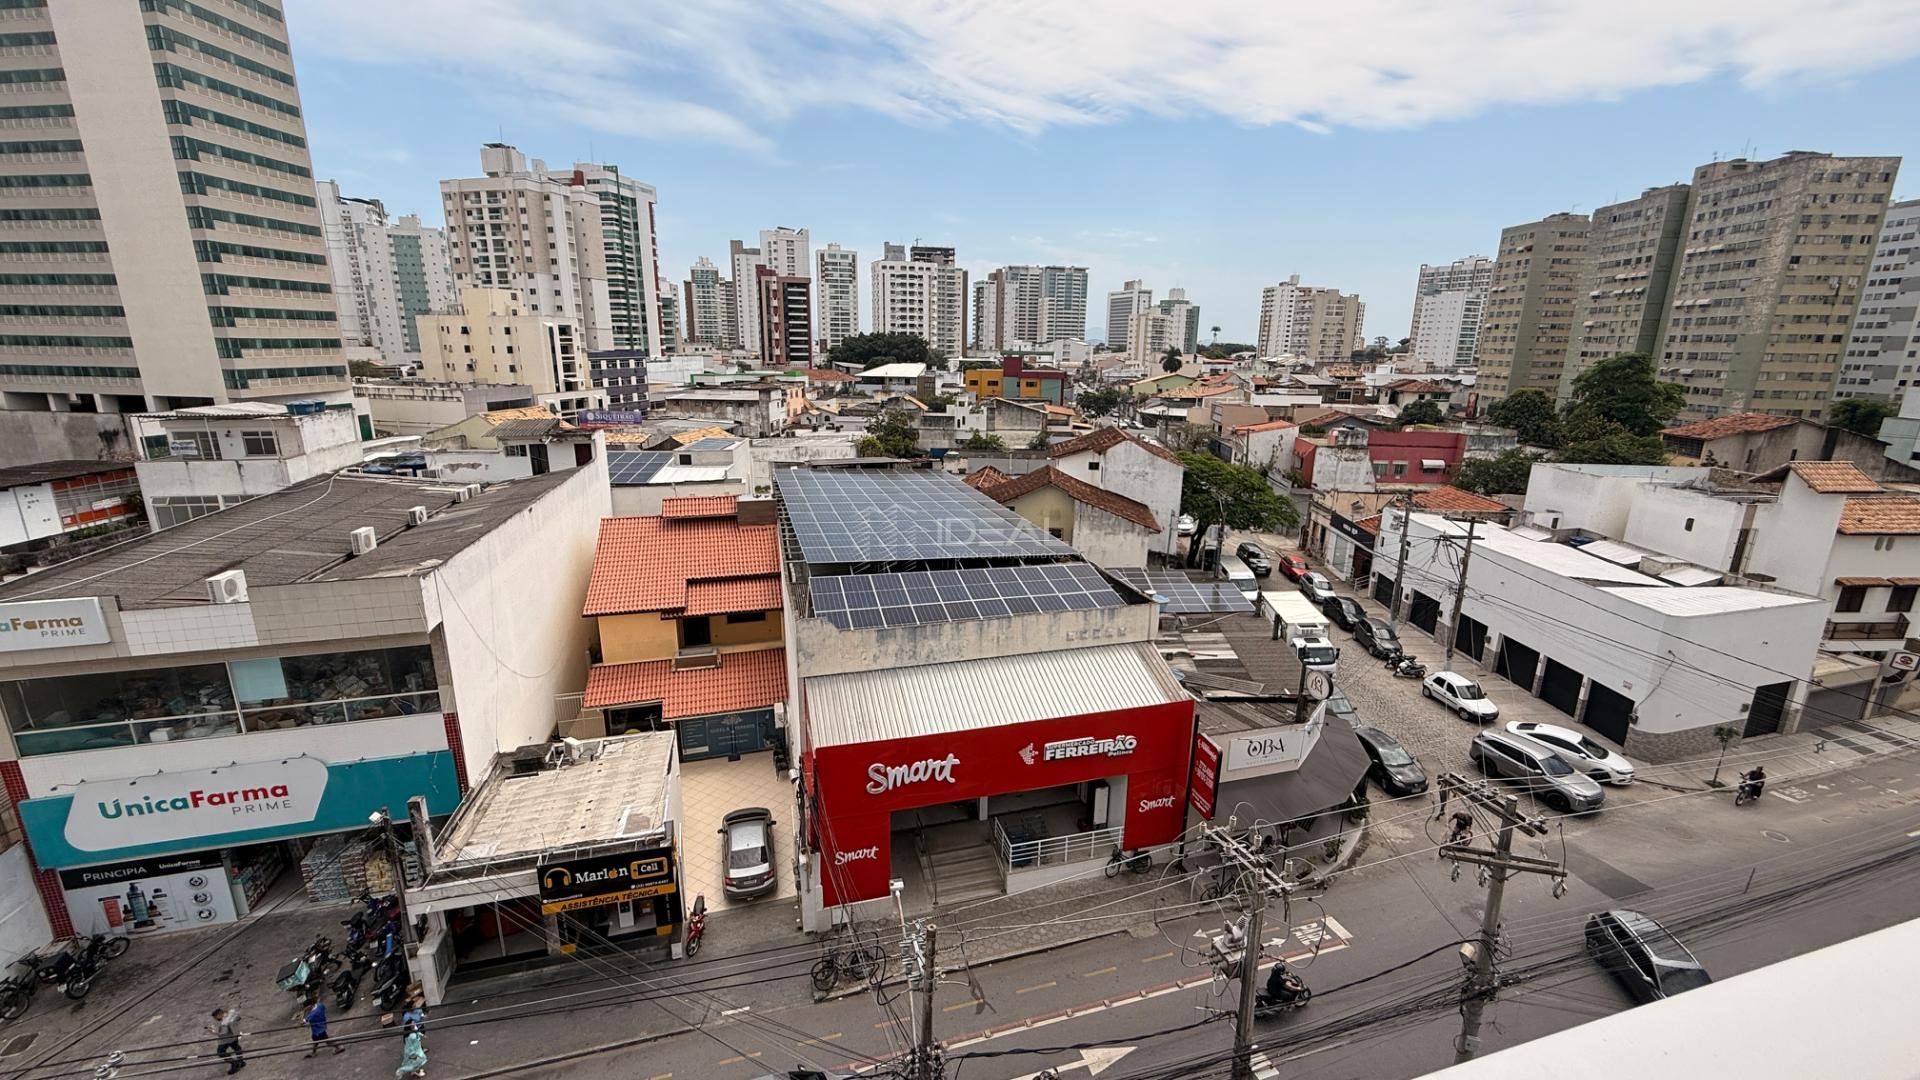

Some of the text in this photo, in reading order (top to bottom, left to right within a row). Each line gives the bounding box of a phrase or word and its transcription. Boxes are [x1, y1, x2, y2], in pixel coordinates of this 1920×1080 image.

[41, 628, 86, 638] PRIME
[1044, 735, 1137, 760] FERREIRÃO
[866, 753, 960, 794] Smart
[98, 785, 289, 820] ÚnicaFarma
[231, 800, 292, 816] PRIME
[1139, 796, 1176, 812] Smart
[835, 846, 879, 865] Smart
[83, 866, 147, 882] PRINCIPIA
[640, 863, 659, 873] Cell
[560, 897, 620, 911] ASSISTÊNCIA
[622, 888, 659, 900] TÉCNICA
